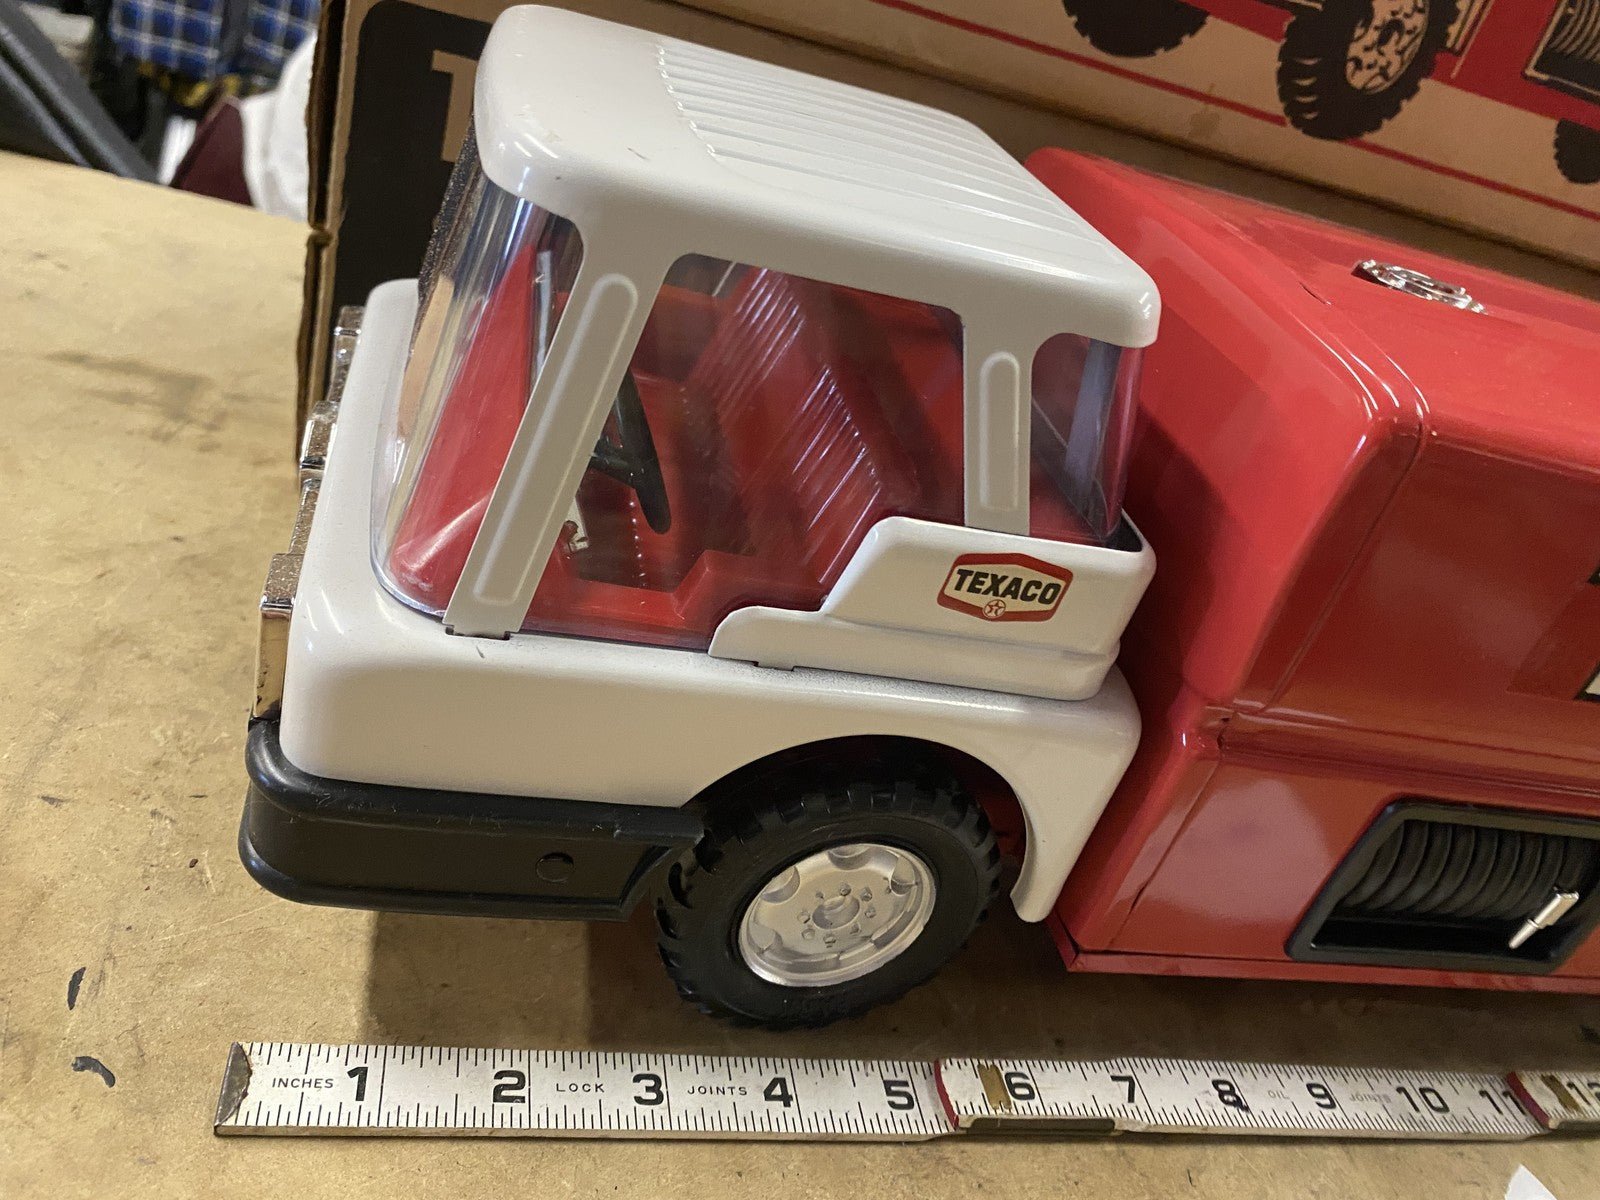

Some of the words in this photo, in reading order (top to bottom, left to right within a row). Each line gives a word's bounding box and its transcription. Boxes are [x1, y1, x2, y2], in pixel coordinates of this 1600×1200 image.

[954, 568, 1062, 605] TEXACO
[271, 1076, 335, 1089] INCHES
[346, 1066, 369, 1102] 1
[492, 1070, 526, 1104] 2
[555, 1082, 605, 1094] LOCK
[633, 1073, 664, 1106] 3
[687, 1083, 748, 1096] JOINTS
[762, 1076, 793, 1108] 4
[883, 1080, 915, 1111] 5
[1004, 1071, 1036, 1101] 6
[1110, 1074, 1136, 1104] 7
[1211, 1078, 1245, 1109] 8
[1306, 1082, 1337, 1110] 9
[1395, 1085, 1451, 1114] 10
[1478, 1089, 1528, 1116] 11
